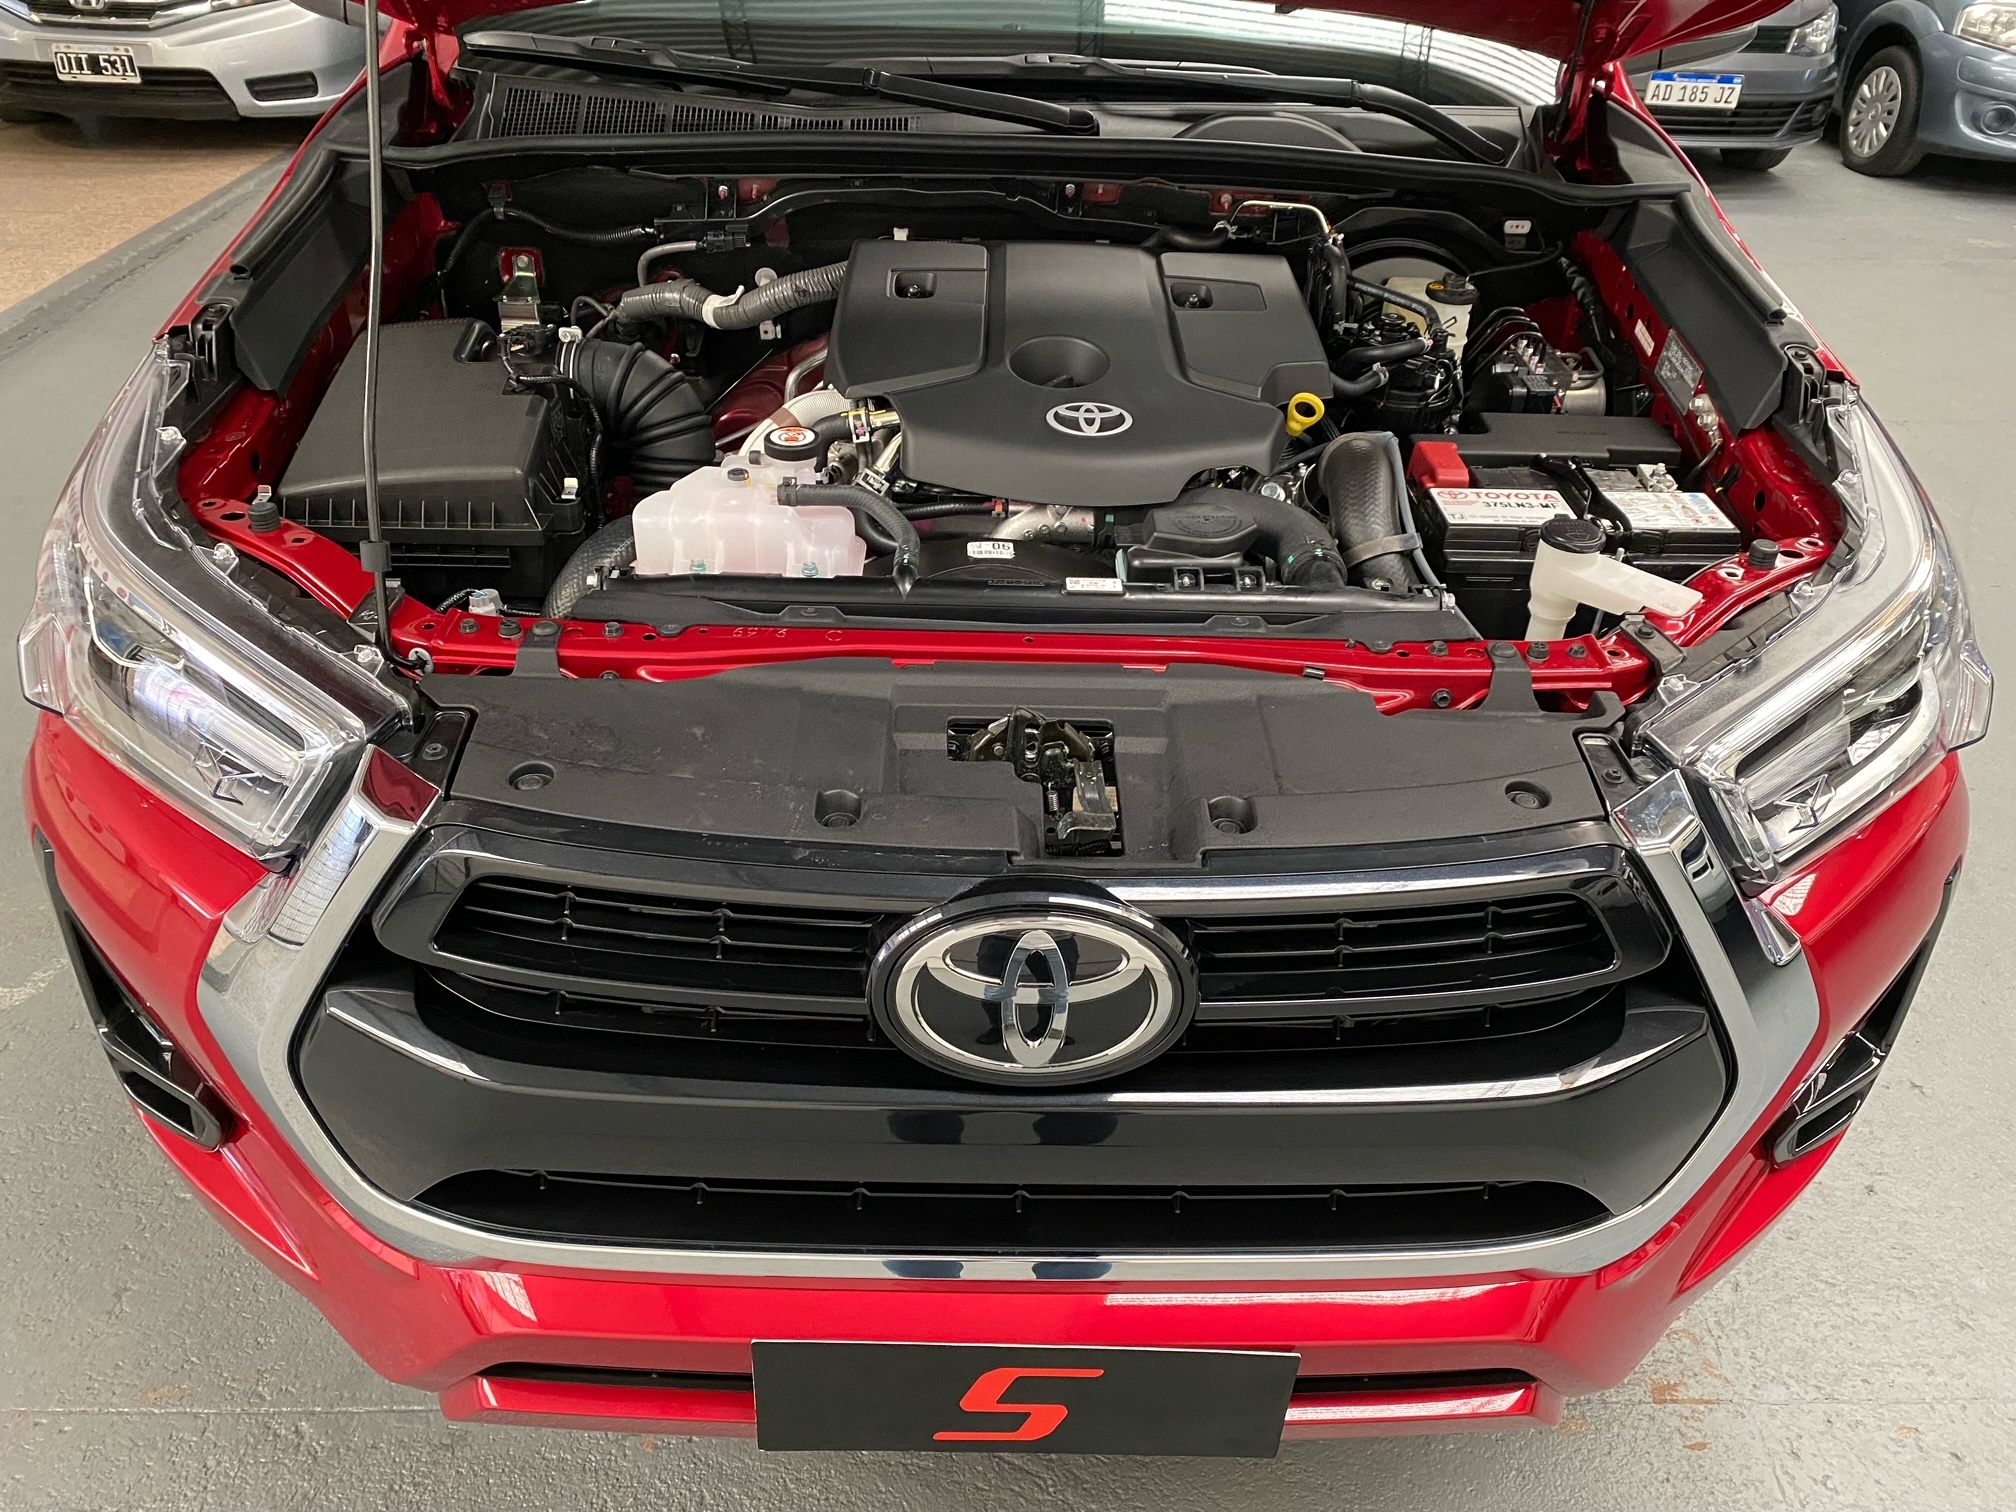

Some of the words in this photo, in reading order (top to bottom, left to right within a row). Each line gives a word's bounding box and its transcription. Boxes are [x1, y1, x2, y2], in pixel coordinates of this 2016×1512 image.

[56, 52, 92, 74] OII
[99, 55, 135, 76] 531
[1651, 84, 1673, 101] AD
[1677, 85, 1710, 102] 185
[1714, 87, 1736, 104] JZ
[1470, 491, 1559, 501] TOYOTA
[932, 1367, 1105, 1441] S
